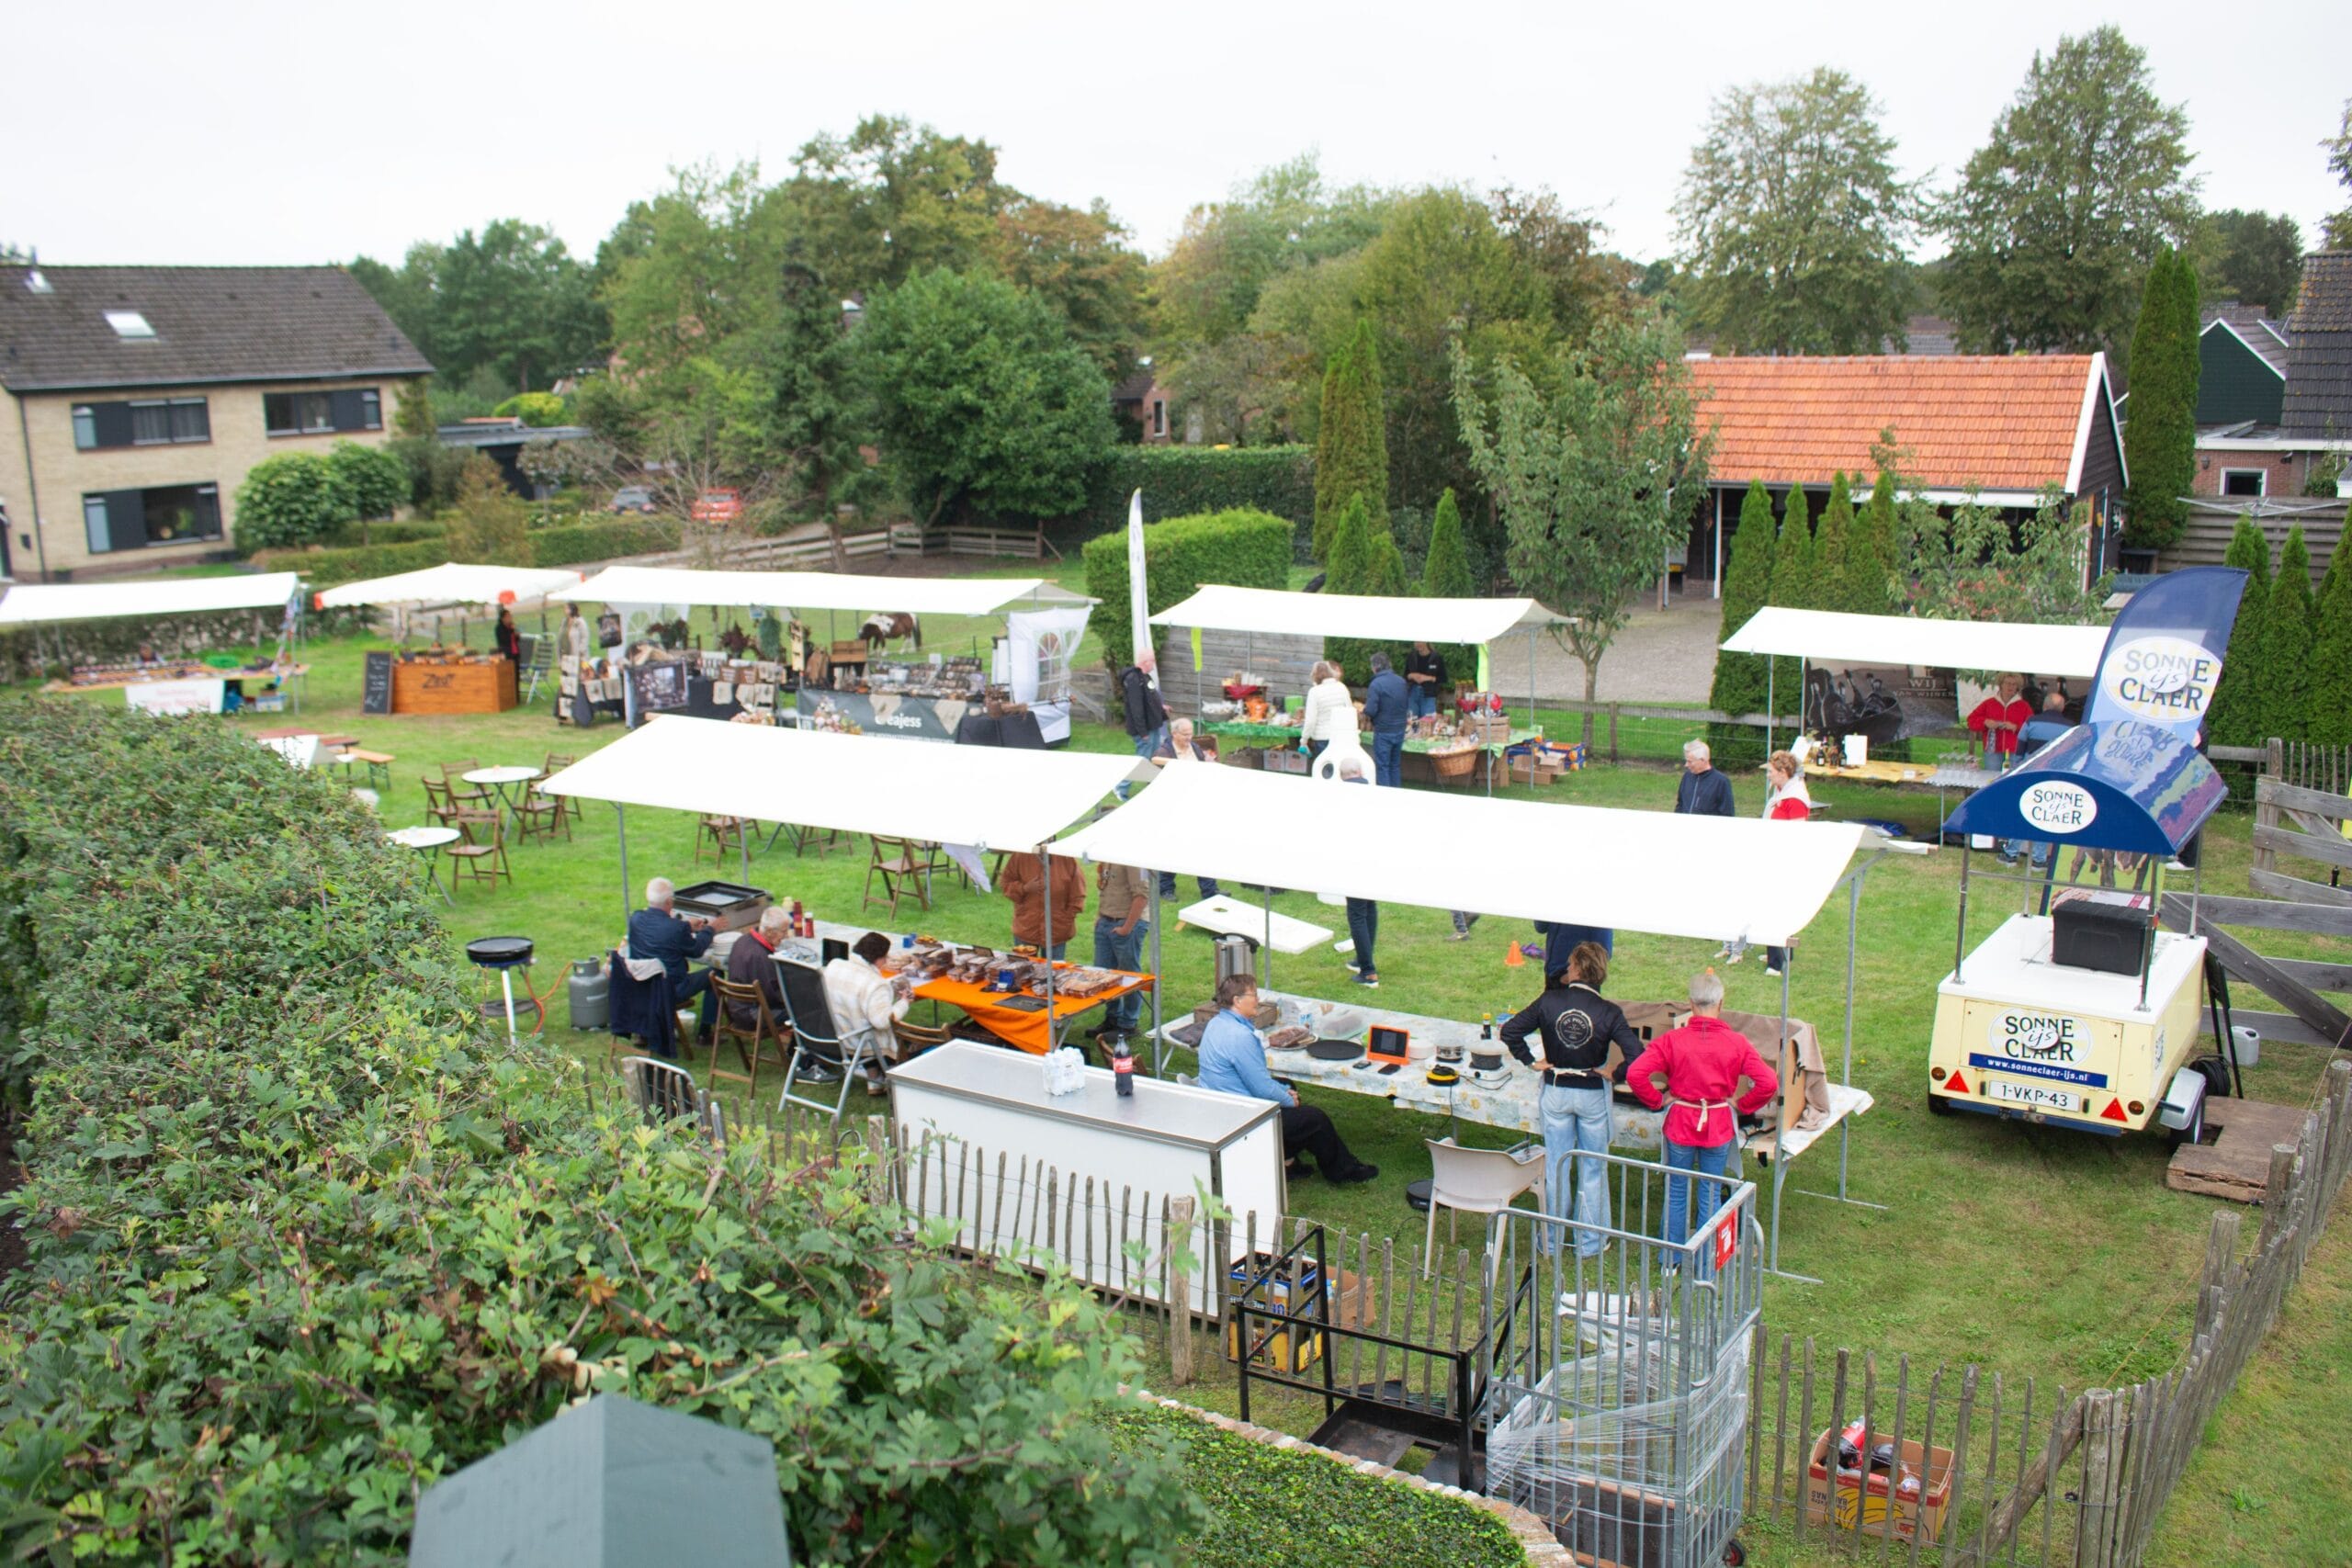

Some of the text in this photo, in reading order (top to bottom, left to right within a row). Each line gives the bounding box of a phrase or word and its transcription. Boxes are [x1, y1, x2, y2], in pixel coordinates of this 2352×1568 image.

[2123, 649, 2211, 683] SONNE
[2119, 677, 2204, 712] CLAER
[874, 712, 922, 729] Ceajess
[2033, 789, 2084, 808] SONNE
[2031, 806, 2082, 825] CLAER
[2005, 1016, 2075, 1038] SONNE
[2028, 1028, 2053, 1048] ijs
[2005, 1038, 2075, 1061] CLAER
[1987, 1058, 2088, 1081] www.sonneclaer-ijs.nl
[2002, 1085, 2068, 1107] 1-VKP-43
[1811, 1490, 1848, 1506] BANAS
